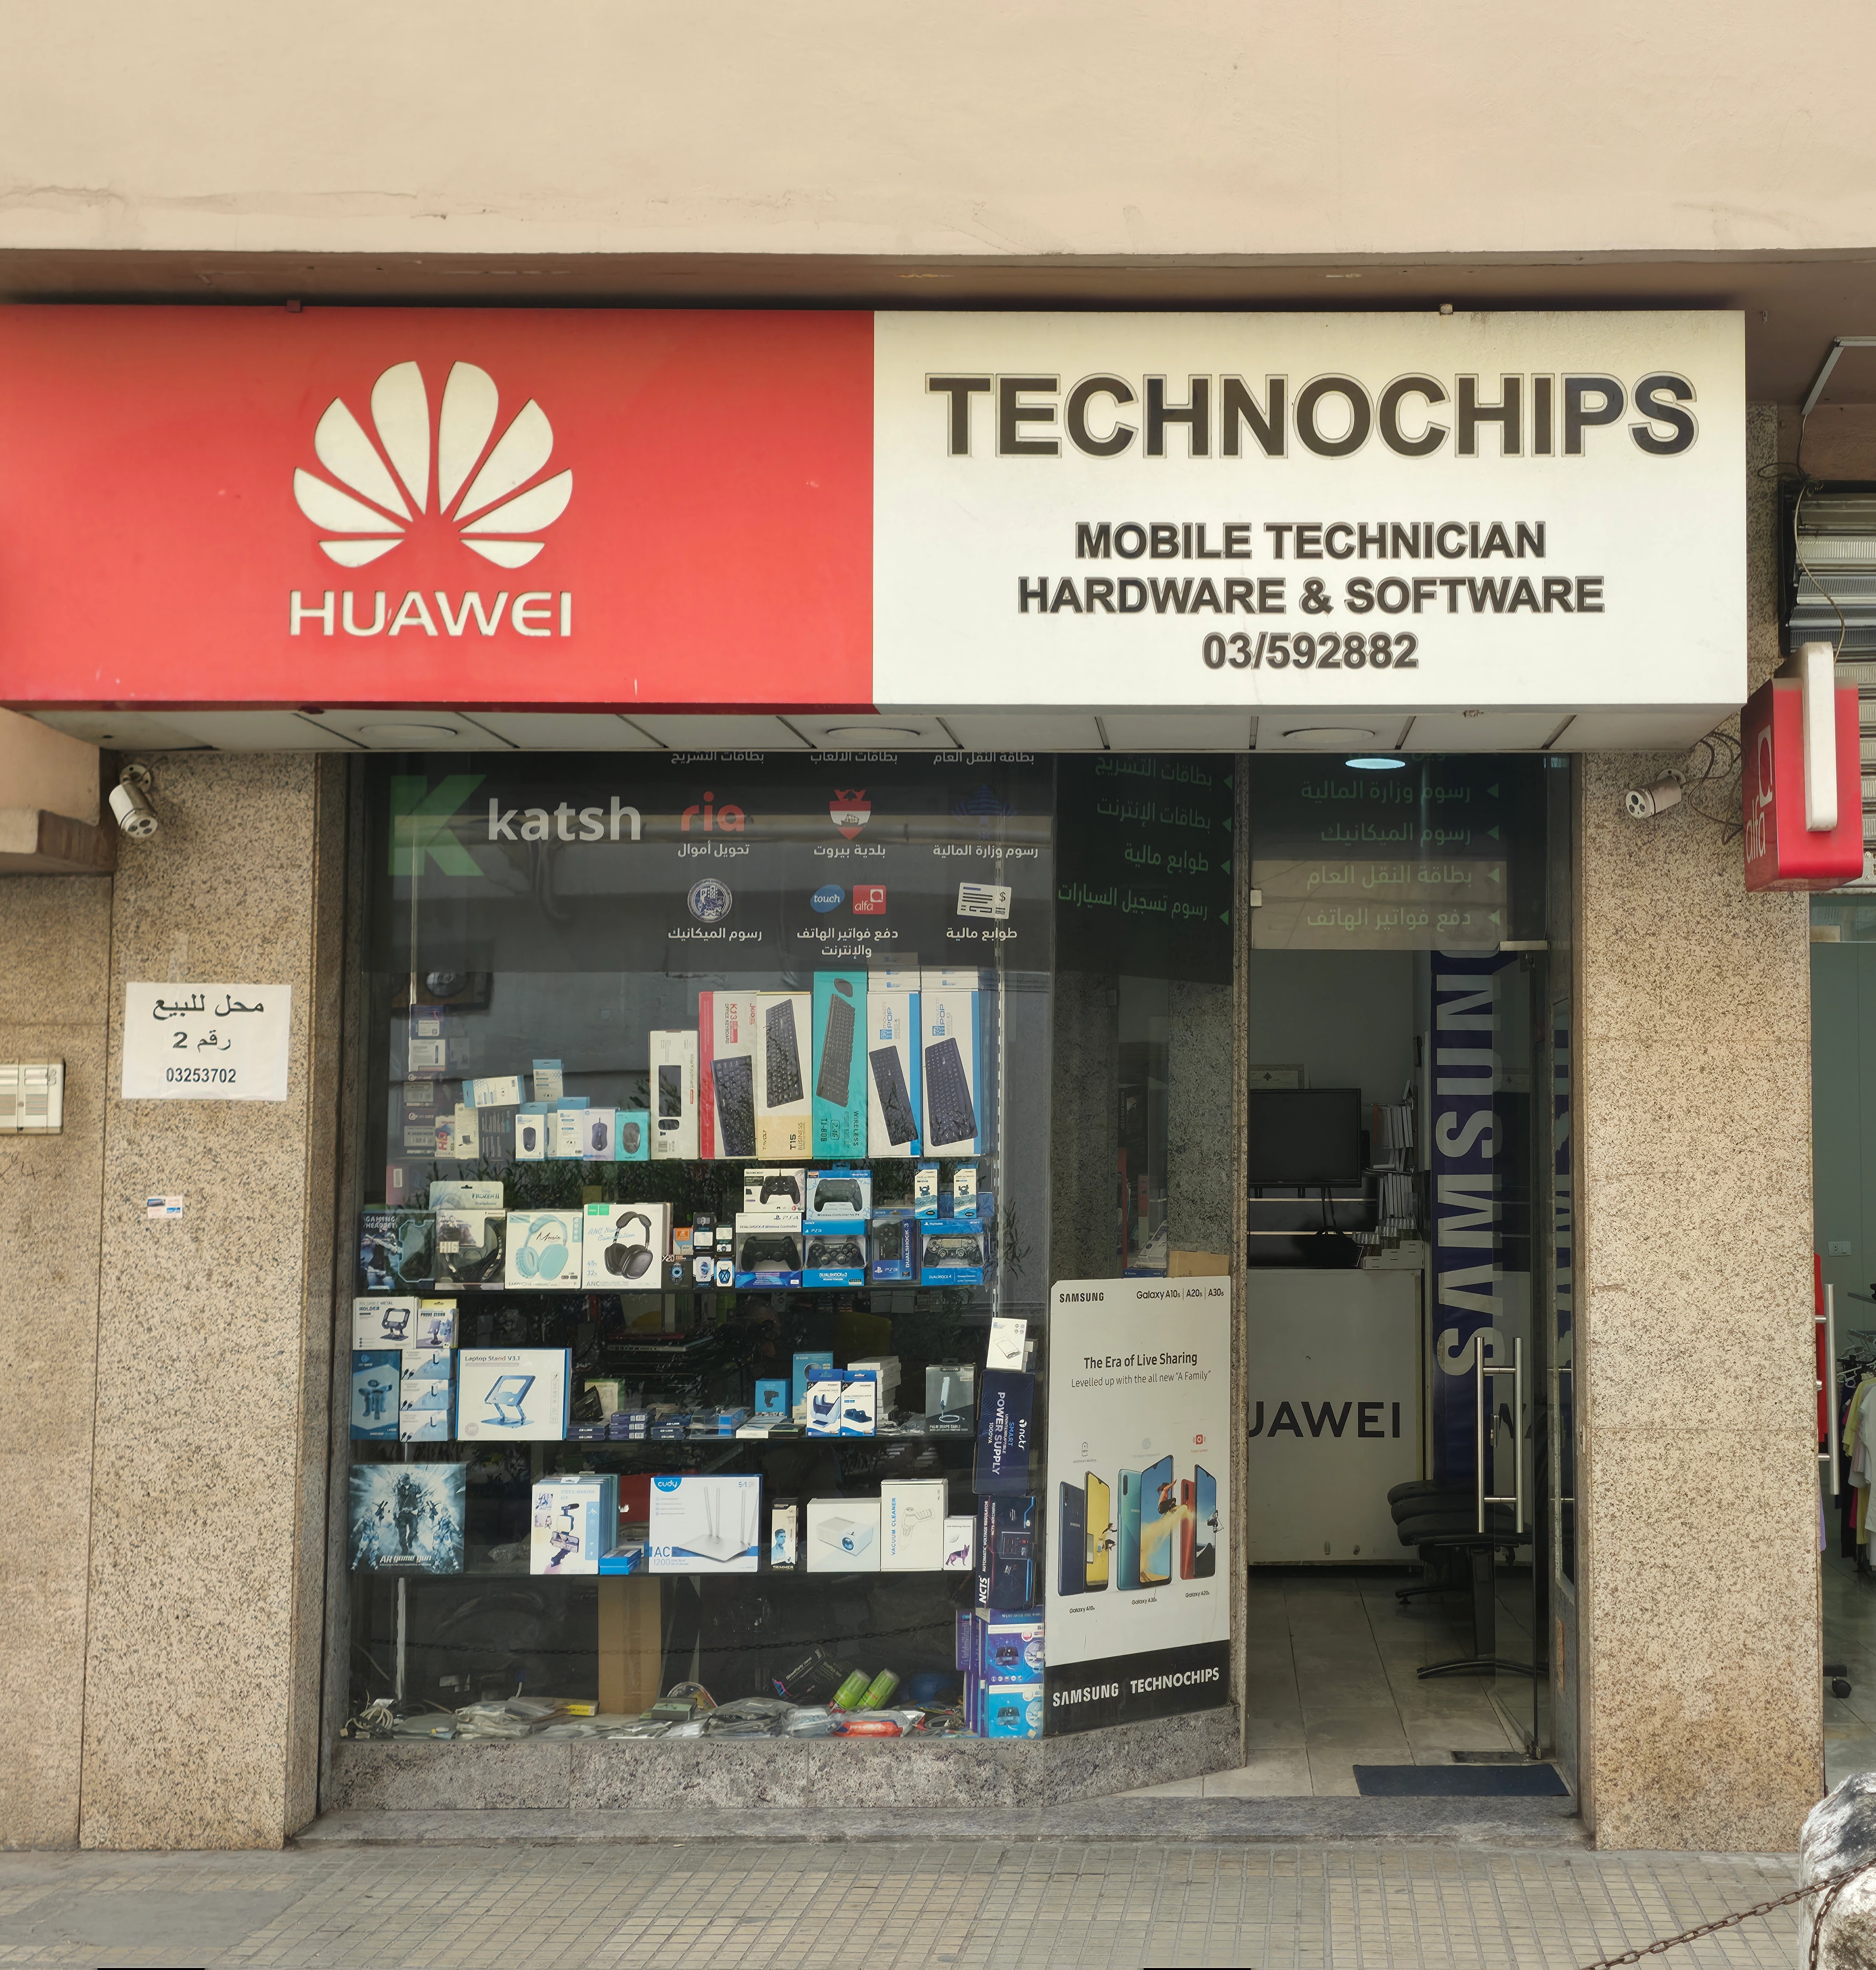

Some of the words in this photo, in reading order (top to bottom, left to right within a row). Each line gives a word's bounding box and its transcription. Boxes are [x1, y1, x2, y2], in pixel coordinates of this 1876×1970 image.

[925, 371, 1698, 459] TECHNOCHIPS
[1074, 521, 1252, 560] MOBILE
[1264, 521, 1546, 560] TECHNICIAN
[1017, 576, 1286, 614] HARDWARE
[1298, 577, 1333, 615] &
[1343, 576, 1605, 615] SOFTWARE
[290, 590, 572, 636] HUAWEI
[1202, 632, 1419, 670] 03/592882
[489, 796, 640, 841] katsh
[681, 791, 745, 832] ria
[1420, 827, 1471, 848] رسوم
[678, 840, 711, 857] أموال
[714, 843, 750, 857] تحويل
[813, 846, 850, 858] بيروت
[854, 844, 886, 858] بلدية
[933, 845, 972, 858] المالية
[976, 845, 1002, 858] وزارة
[1005, 847, 1039, 858] رسوم
[1125, 843, 1161, 868] مالية
[1167, 850, 1209, 874] طوابع
[1306, 865, 1355, 891] العام
[1362, 865, 1410, 889] النقل
[1418, 865, 1472, 888] بطاقة
[813, 894, 840, 903] touch
[854, 900, 874, 911] alfa
[1058, 882, 1117, 908] السيارات
[1122, 889, 1168, 914] تسجيل
[1172, 901, 1208, 921] رسوم
[1306, 907, 1368, 931] الهاتف
[1375, 907, 1429, 931] فواتير
[1437, 909, 1471, 932] دفع
[668, 927, 725, 941] الميكانيك
[728, 930, 762, 941] رسوم
[796, 927, 834, 942] الهاتف
[837, 928, 871, 942] فواتير
[874, 928, 898, 942] دفع
[946, 927, 978, 942] مالية
[981, 927, 1018, 942] طوابع
[821, 944, 872, 960] والإنترنت
[152, 994, 205, 1020] للبيع
[214, 994, 264, 1017] محل
[172, 1031, 188, 1049] 2
[197, 1029, 231, 1051] رقم
[166, 1067, 236, 1083] 03253702
[1436, 951, 1505, 1376] SAMSUN
[536, 1232, 561, 1241] Music
[1059, 1292, 1104, 1303] SAMSUNG
[1136, 1290, 1164, 1301] Galaxy
[1165, 1289, 1180, 1298] A10s
[1186, 1289, 1202, 1297] A20s
[1208, 1288, 1224, 1297] A30s
[1084, 1357, 1103, 1369] The
[1106, 1356, 1122, 1368] Era
[1124, 1355, 1134, 1367] of
[1137, 1354, 1157, 1366] Live
[1159, 1352, 1197, 1366] Sharing
[1071, 1377, 1103, 1388] Levelled
[1105, 1378, 1114, 1387] up
[1116, 1374, 1132, 1385] with
[1134, 1374, 1146, 1384] the
[1148, 1373, 1157, 1383] all
[995, 1392, 1005, 1433] POWER
[1018, 1429, 1026, 1450] ncts
[992, 1435, 1002, 1475] SUPPLY
[654, 1546, 670, 1557] AC
[979, 1577, 987, 1604] NCTS
[1053, 1683, 1119, 1707] SAMSUNG
[1130, 1667, 1219, 1694] TECHNOCHIPS
